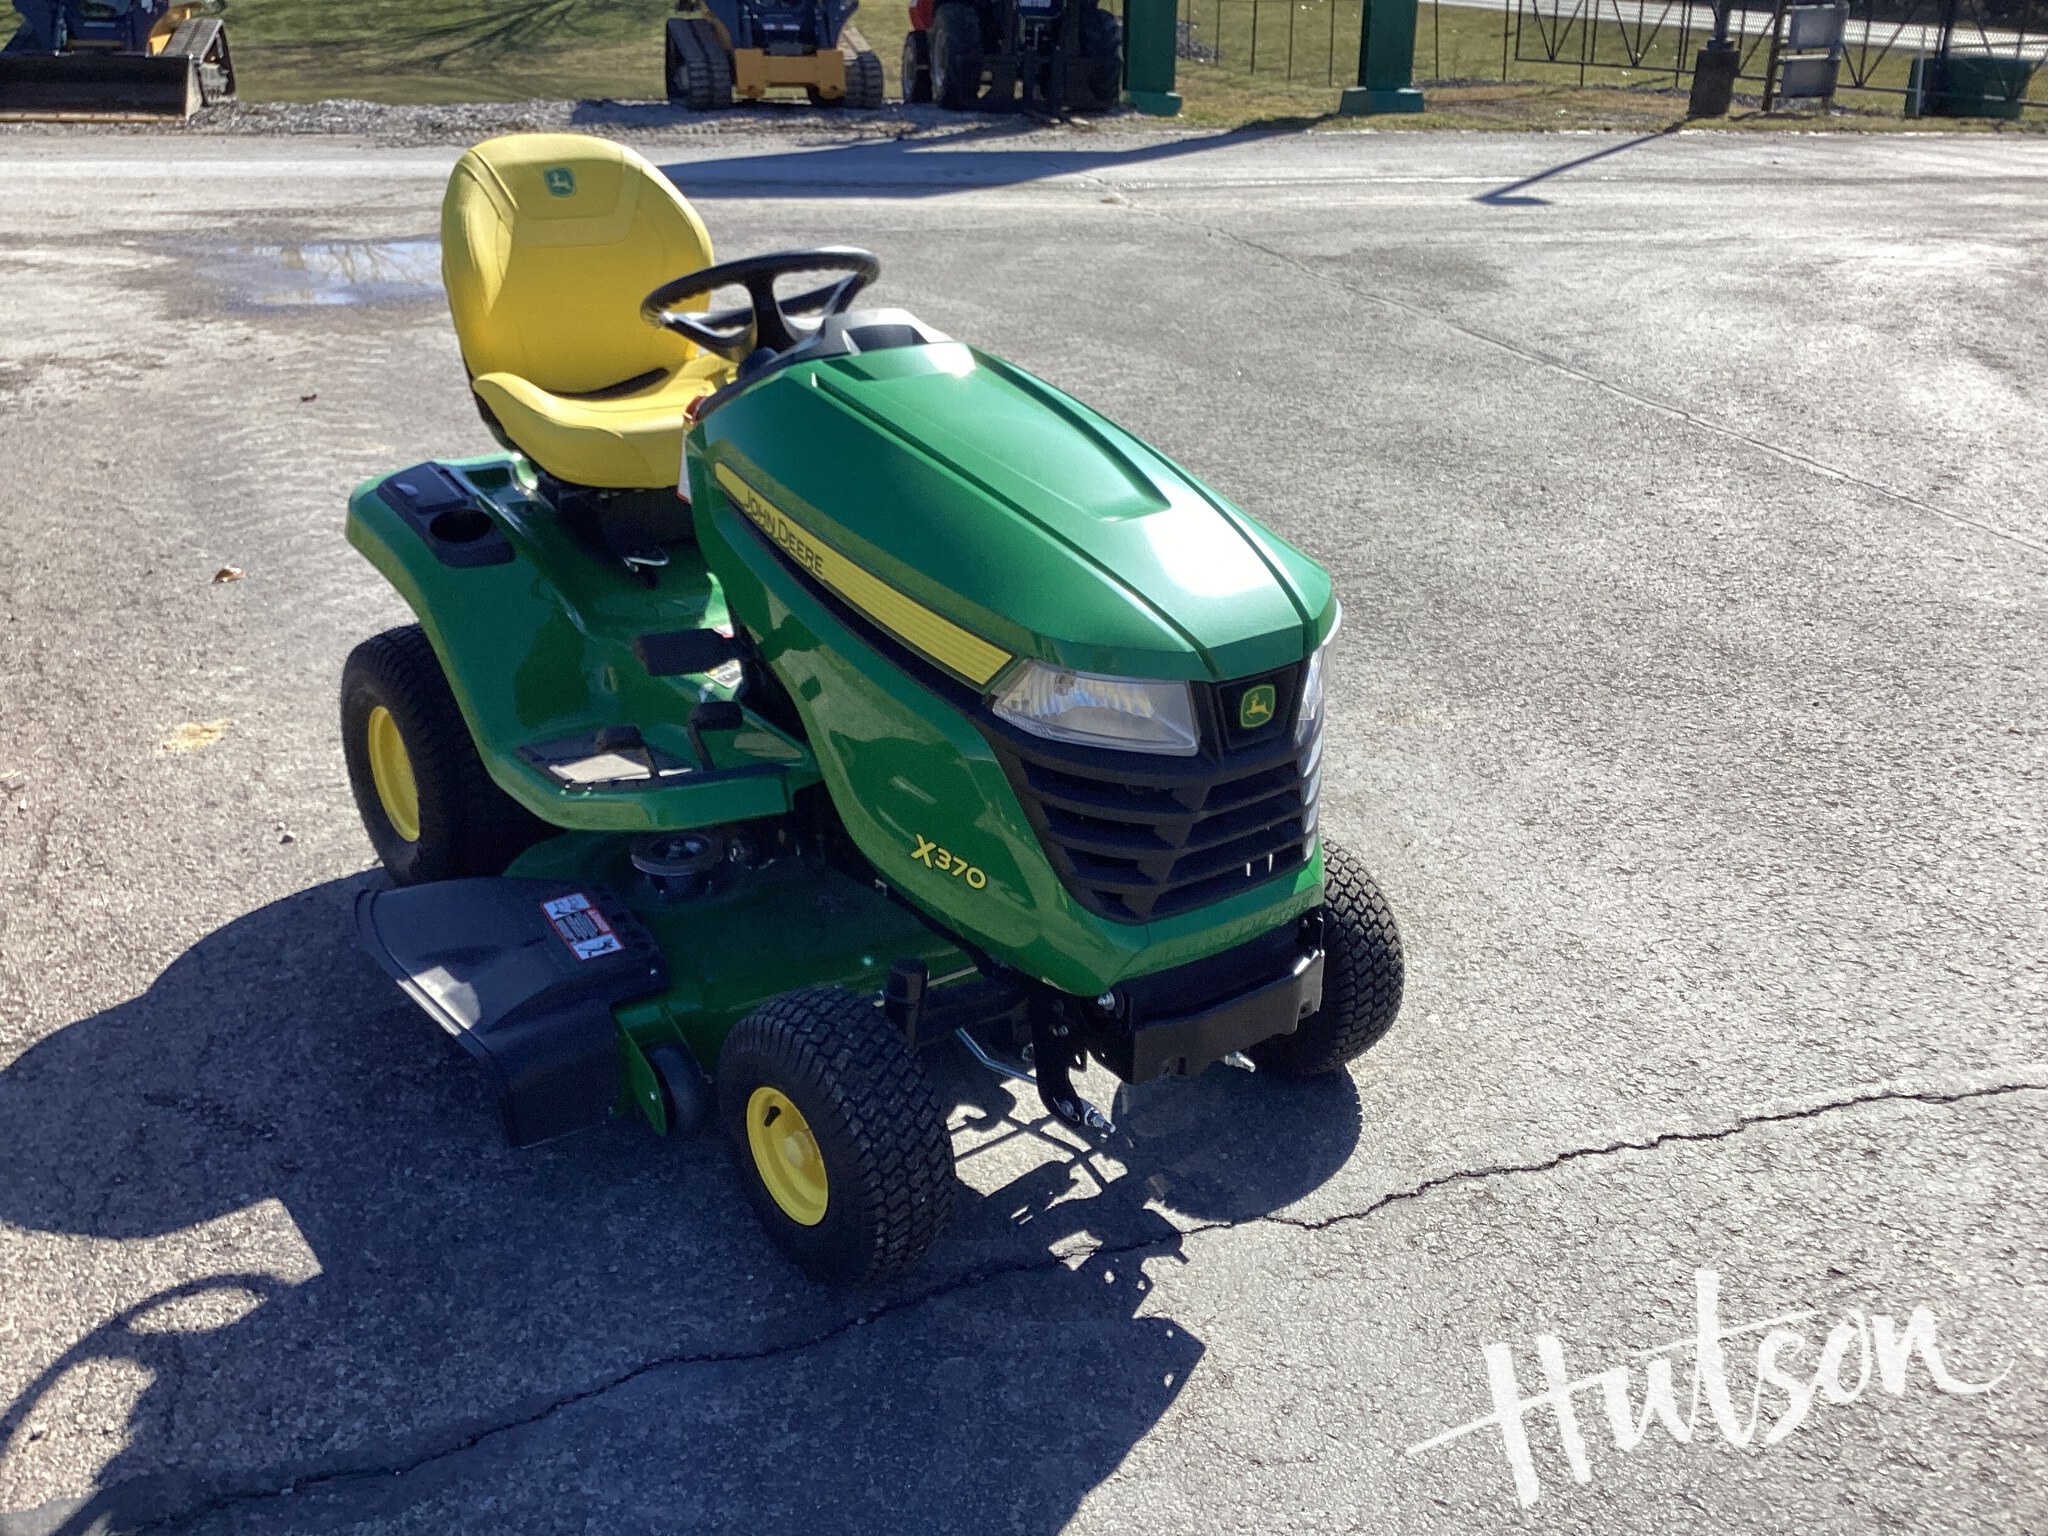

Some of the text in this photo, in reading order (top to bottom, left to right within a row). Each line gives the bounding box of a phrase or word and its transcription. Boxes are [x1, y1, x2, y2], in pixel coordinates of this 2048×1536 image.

[744, 489, 823, 575] JOHN DEERE
[911, 833, 987, 889] X370
